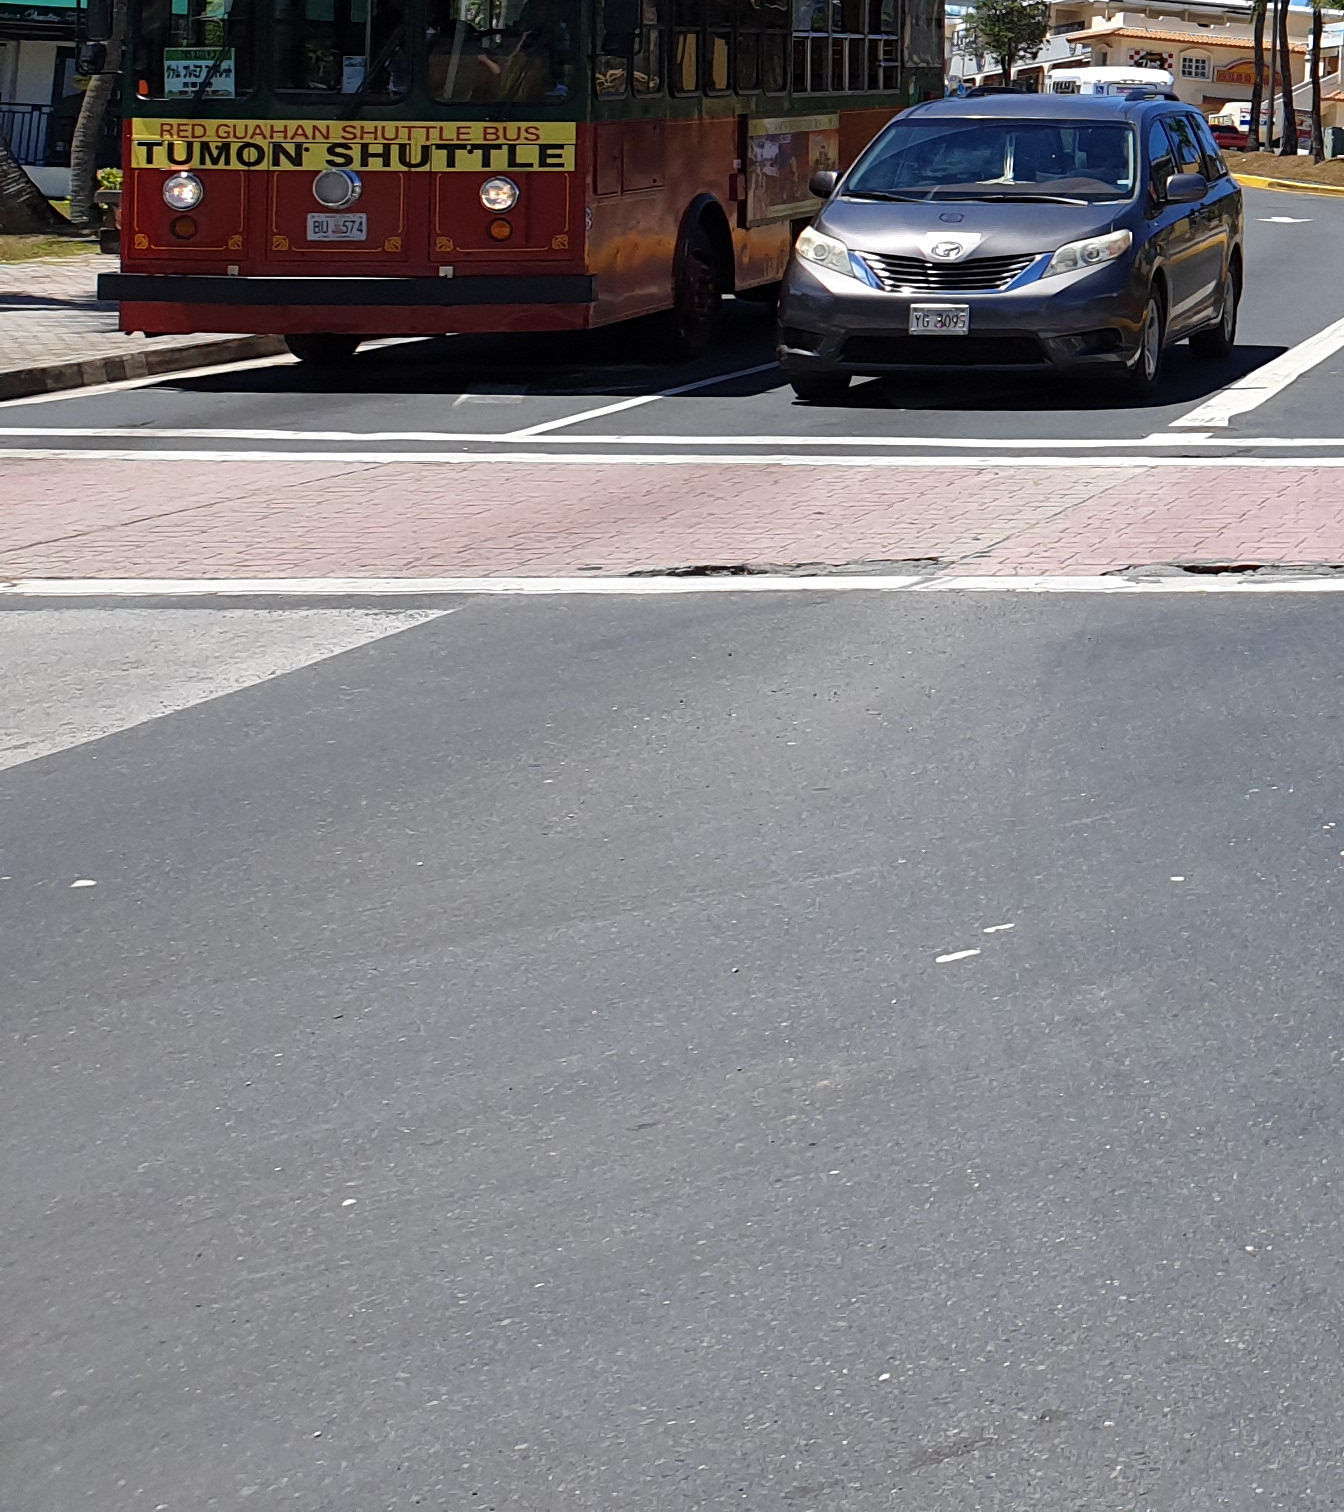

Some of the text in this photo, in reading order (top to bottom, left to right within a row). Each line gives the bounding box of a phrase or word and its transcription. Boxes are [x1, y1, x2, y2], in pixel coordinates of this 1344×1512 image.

[160, 123, 541, 142] RED GUAHAN SHUTTLE BUS
[137, 141, 565, 169] TUMON SHUTTLE
[313, 220, 363, 234] BU 574
[915, 313, 930, 328] YG
